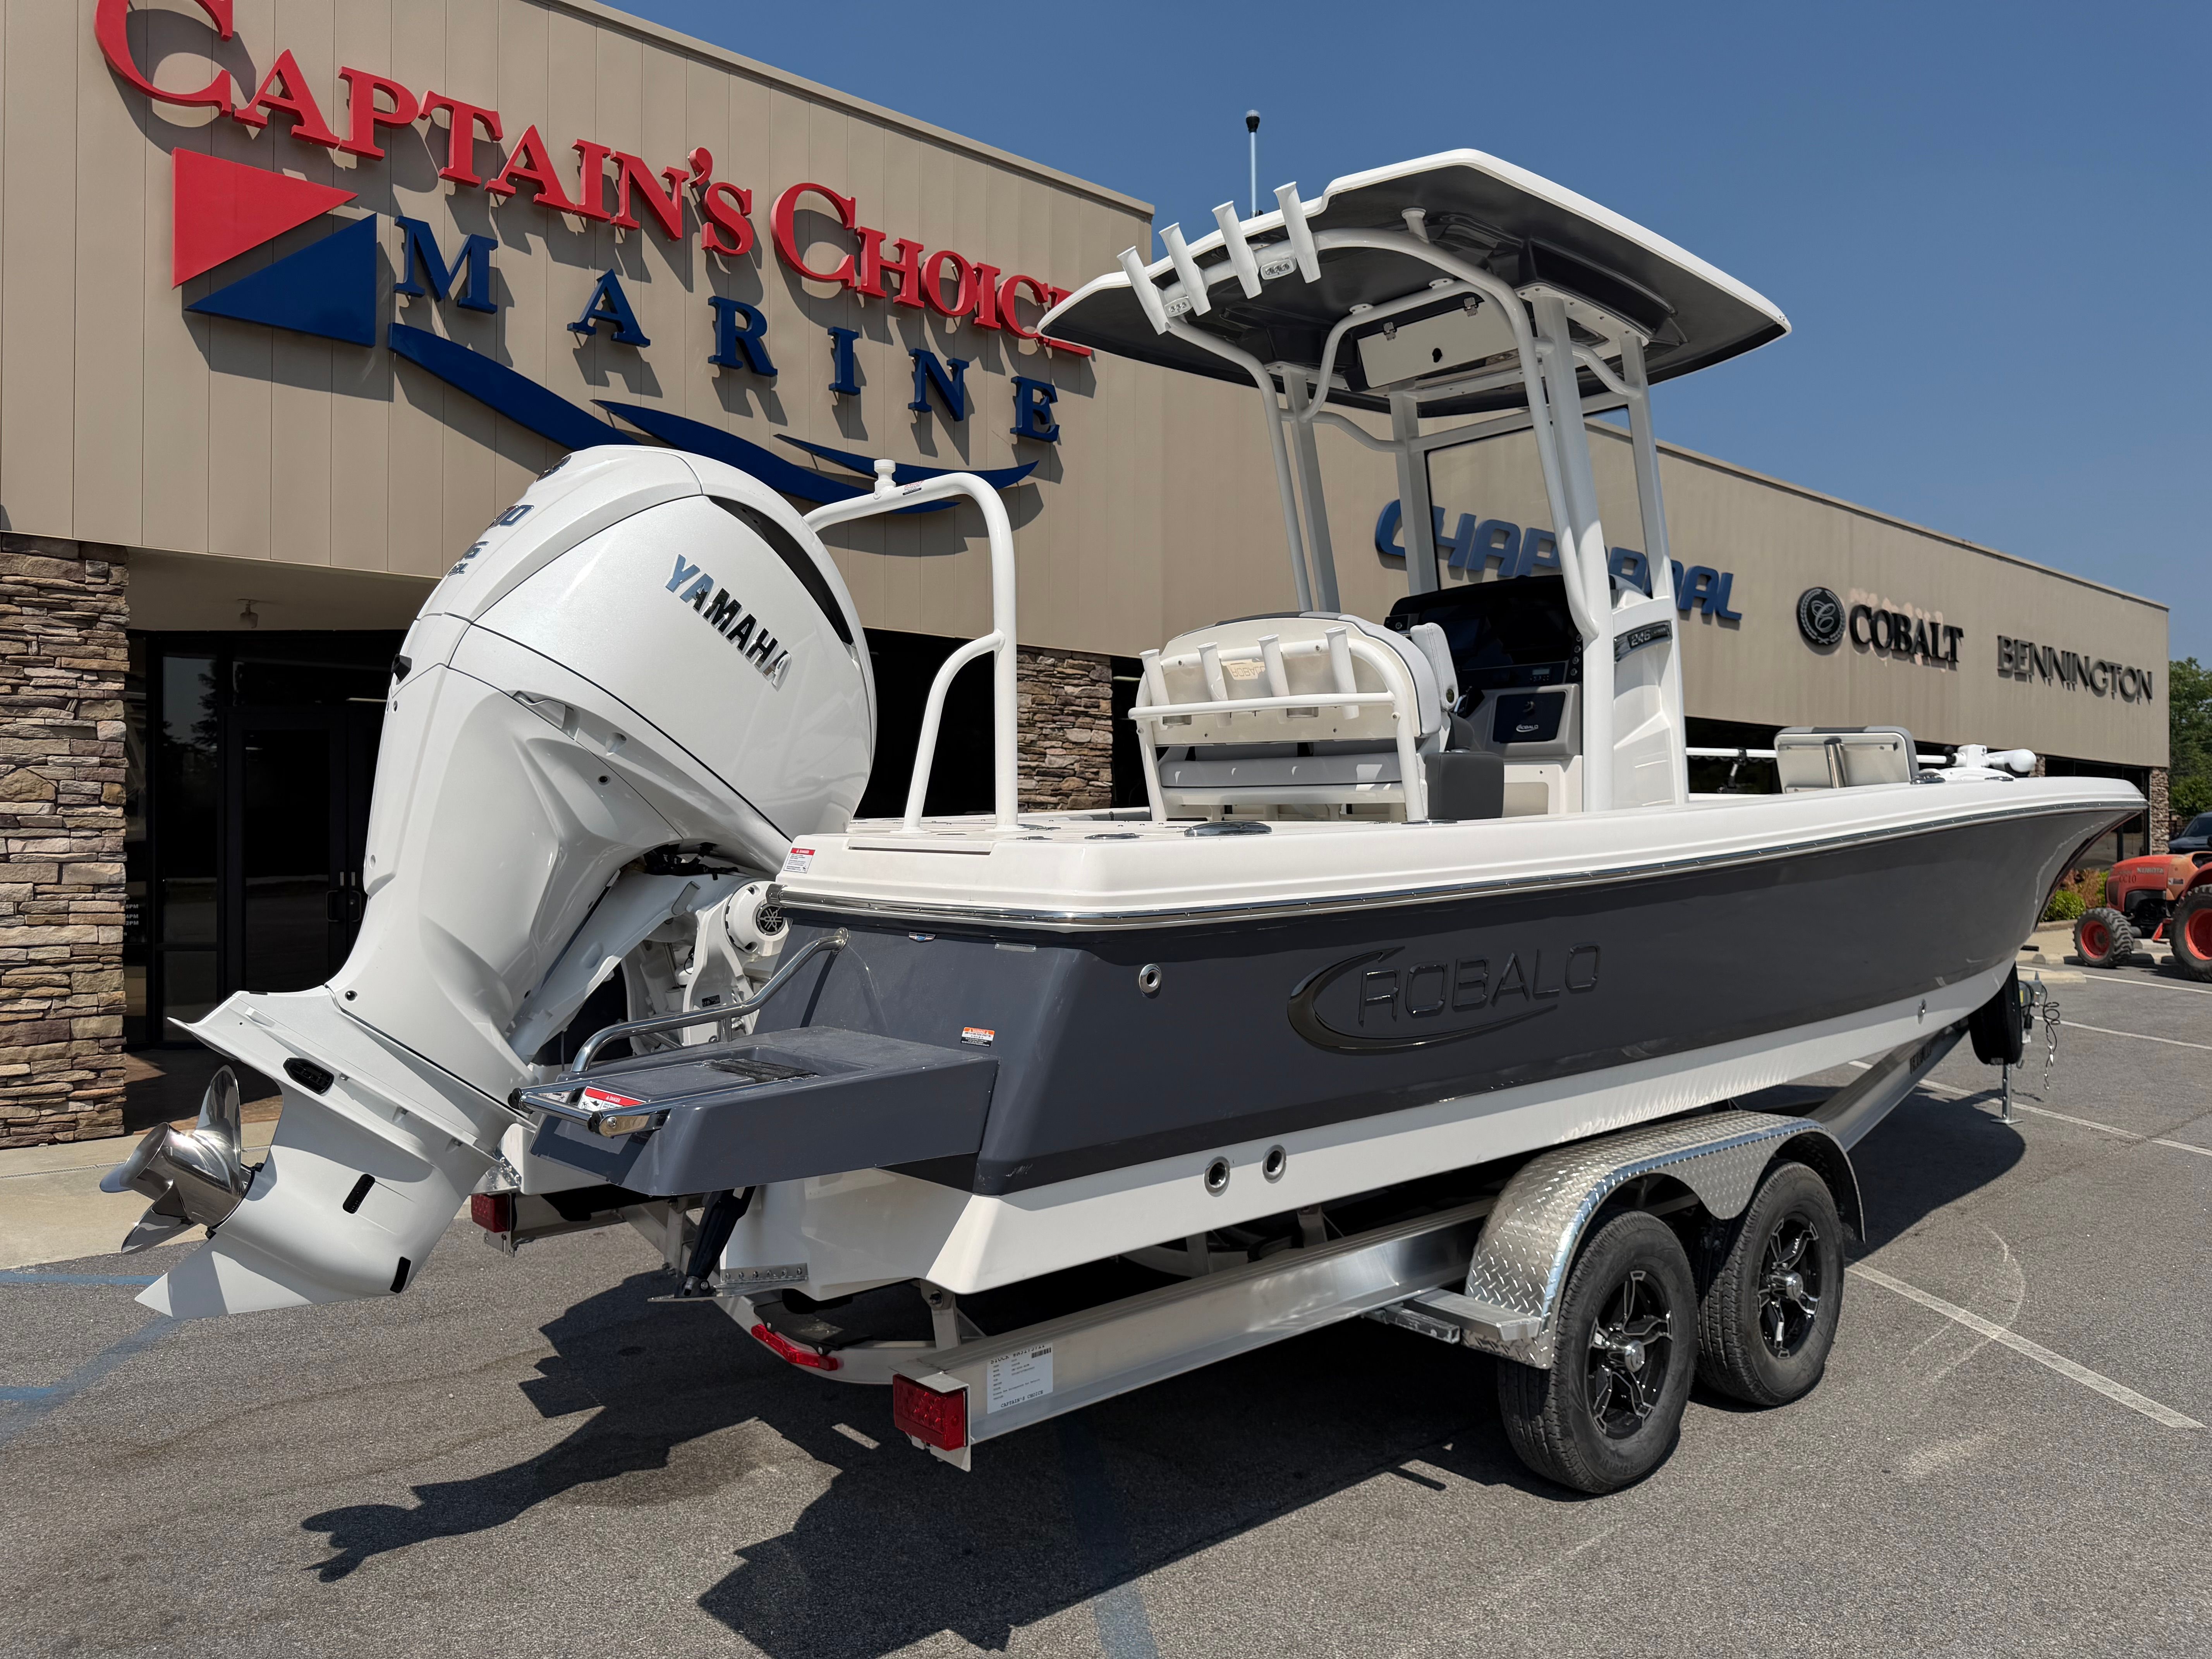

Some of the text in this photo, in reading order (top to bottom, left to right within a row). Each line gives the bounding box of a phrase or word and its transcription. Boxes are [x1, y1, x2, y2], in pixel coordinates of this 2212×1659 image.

[94, 0, 752, 256] CAPTAIN'S
[393, 215, 1060, 443] MARINE
[665, 554, 792, 692] YAMAHA
[1849, 605, 1964, 663] COBALT
[1997, 635, 2153, 700] BENNINGTON
[1358, 942, 1601, 1027] ROBALO
[1001, 1396, 1025, 1408] CAPTAIN'S
[1027, 1390, 1043, 1399] CHOICE
